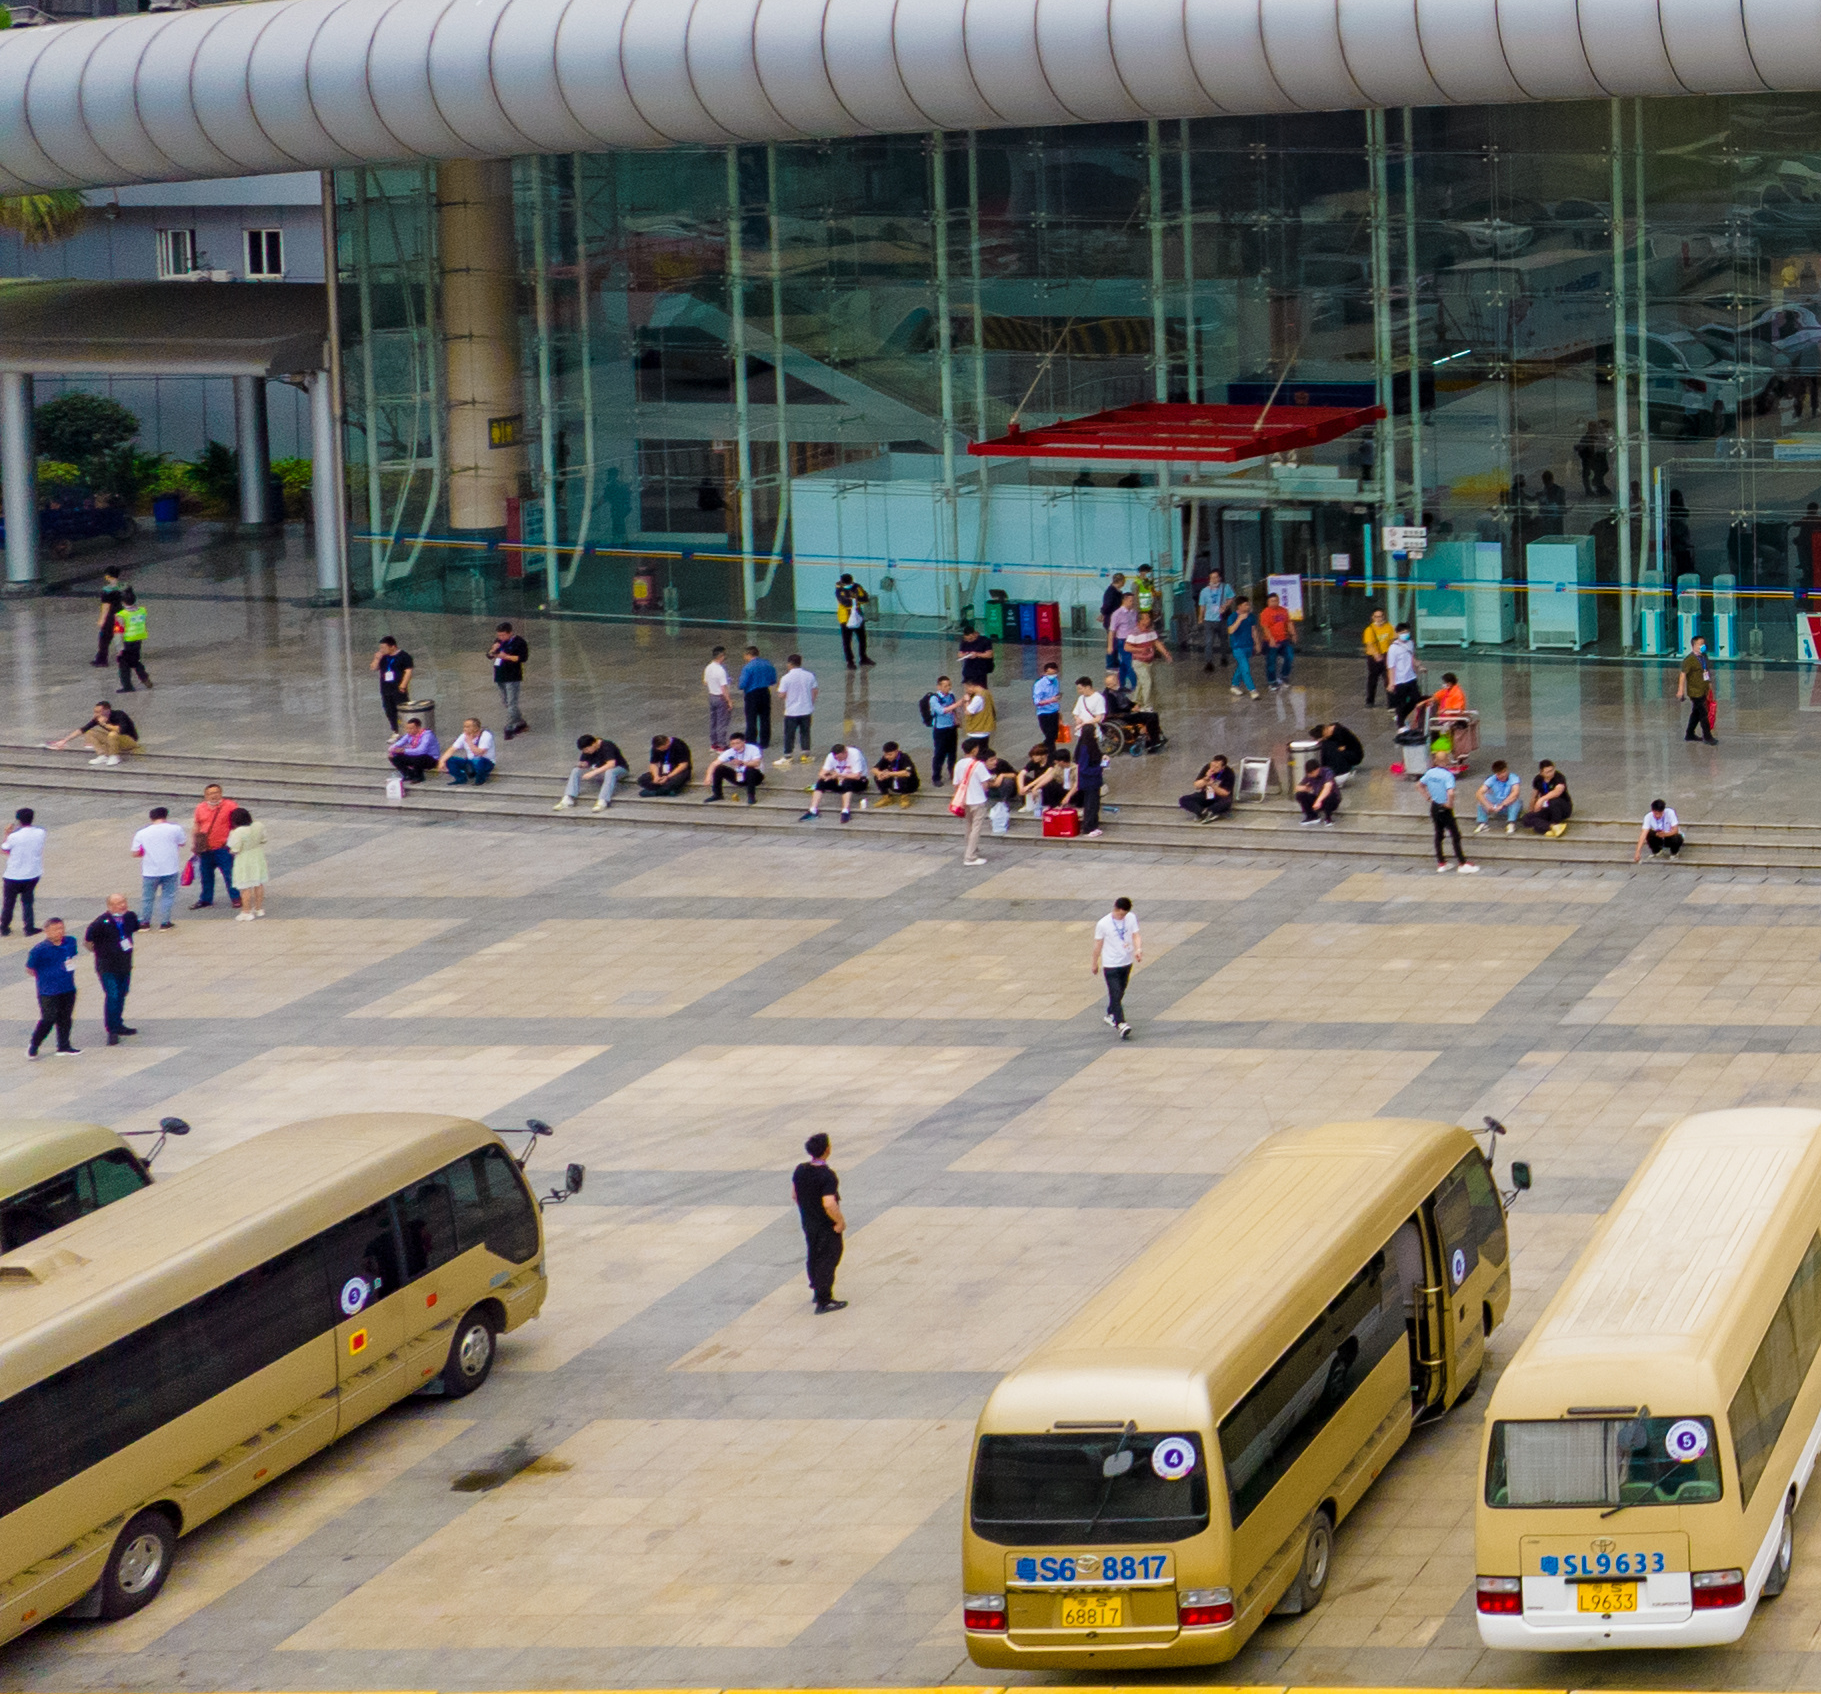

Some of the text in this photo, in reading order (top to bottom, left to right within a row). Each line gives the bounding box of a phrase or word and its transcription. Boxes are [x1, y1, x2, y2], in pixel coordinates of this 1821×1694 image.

[1682, 1434, 1692, 1448] 5
[1169, 1451, 1179, 1466] 4
[1102, 1555, 1167, 1580] 8817
[1580, 1594, 1634, 1611] L9633
[1065, 1608, 1119, 1624] 68817
